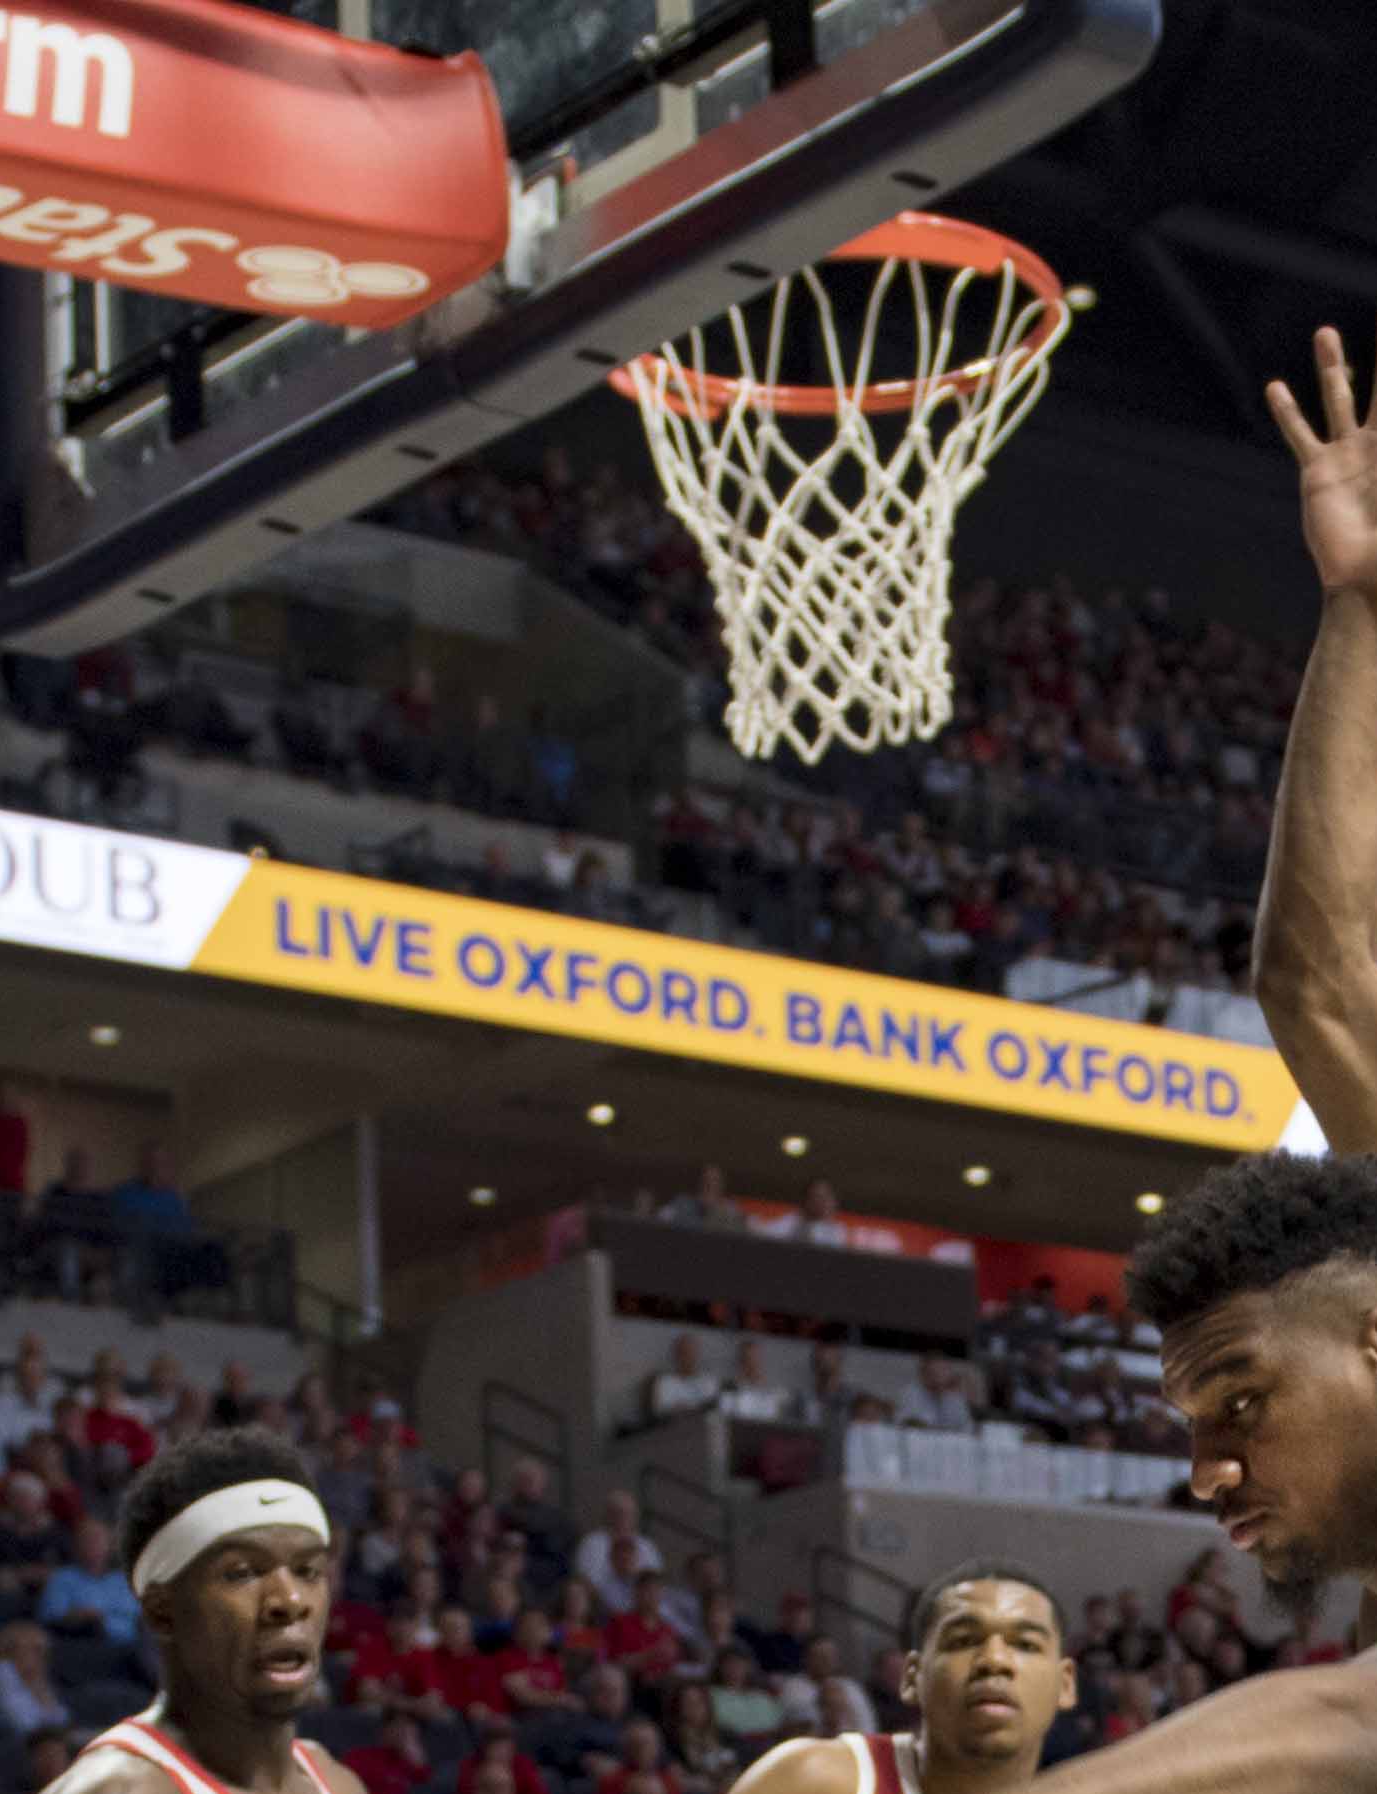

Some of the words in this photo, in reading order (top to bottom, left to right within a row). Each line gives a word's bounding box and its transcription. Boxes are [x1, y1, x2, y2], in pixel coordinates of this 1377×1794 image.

[275, 897, 435, 978] LIVE
[457, 934, 767, 1039] OXFORD.
[785, 991, 967, 1073] BANK
[987, 1031, 1257, 1124] OXFORD.
